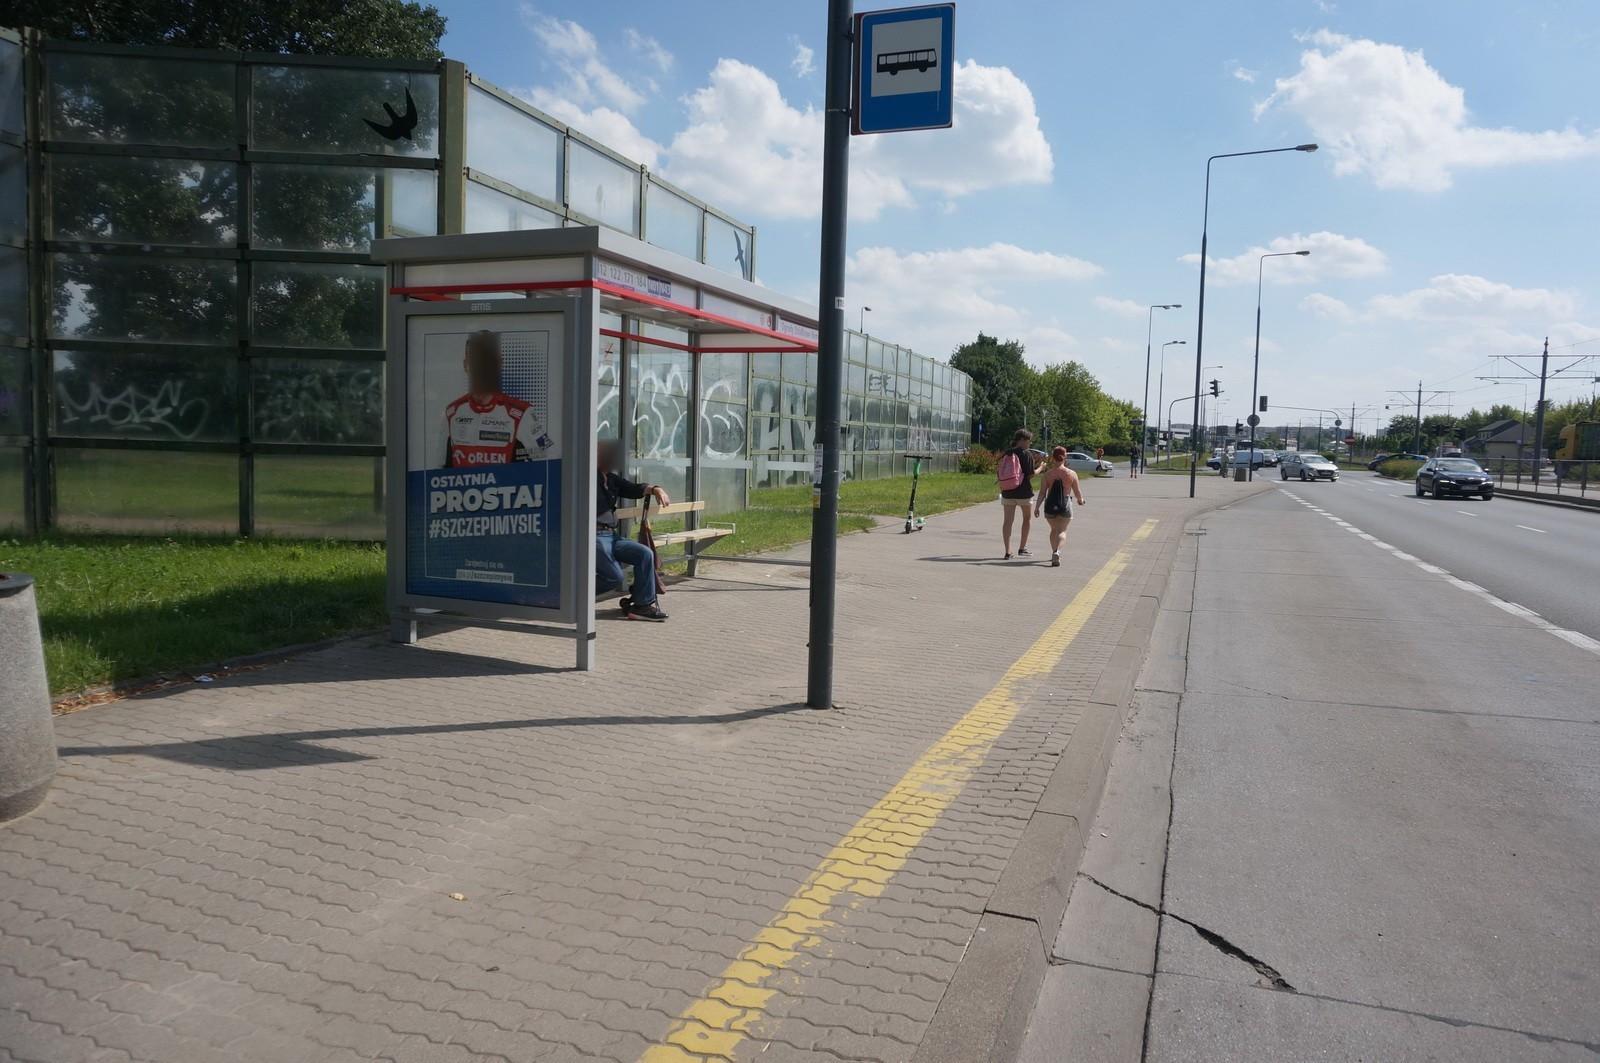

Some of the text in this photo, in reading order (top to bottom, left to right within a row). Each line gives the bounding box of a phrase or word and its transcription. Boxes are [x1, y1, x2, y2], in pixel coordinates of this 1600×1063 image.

[467, 452, 507, 464] ORLEN
[431, 473, 496, 488] OSTATNIA
[430, 484, 543, 514] PROSTA!
[429, 513, 541, 538] #SZCZEPIMYSIĘ
